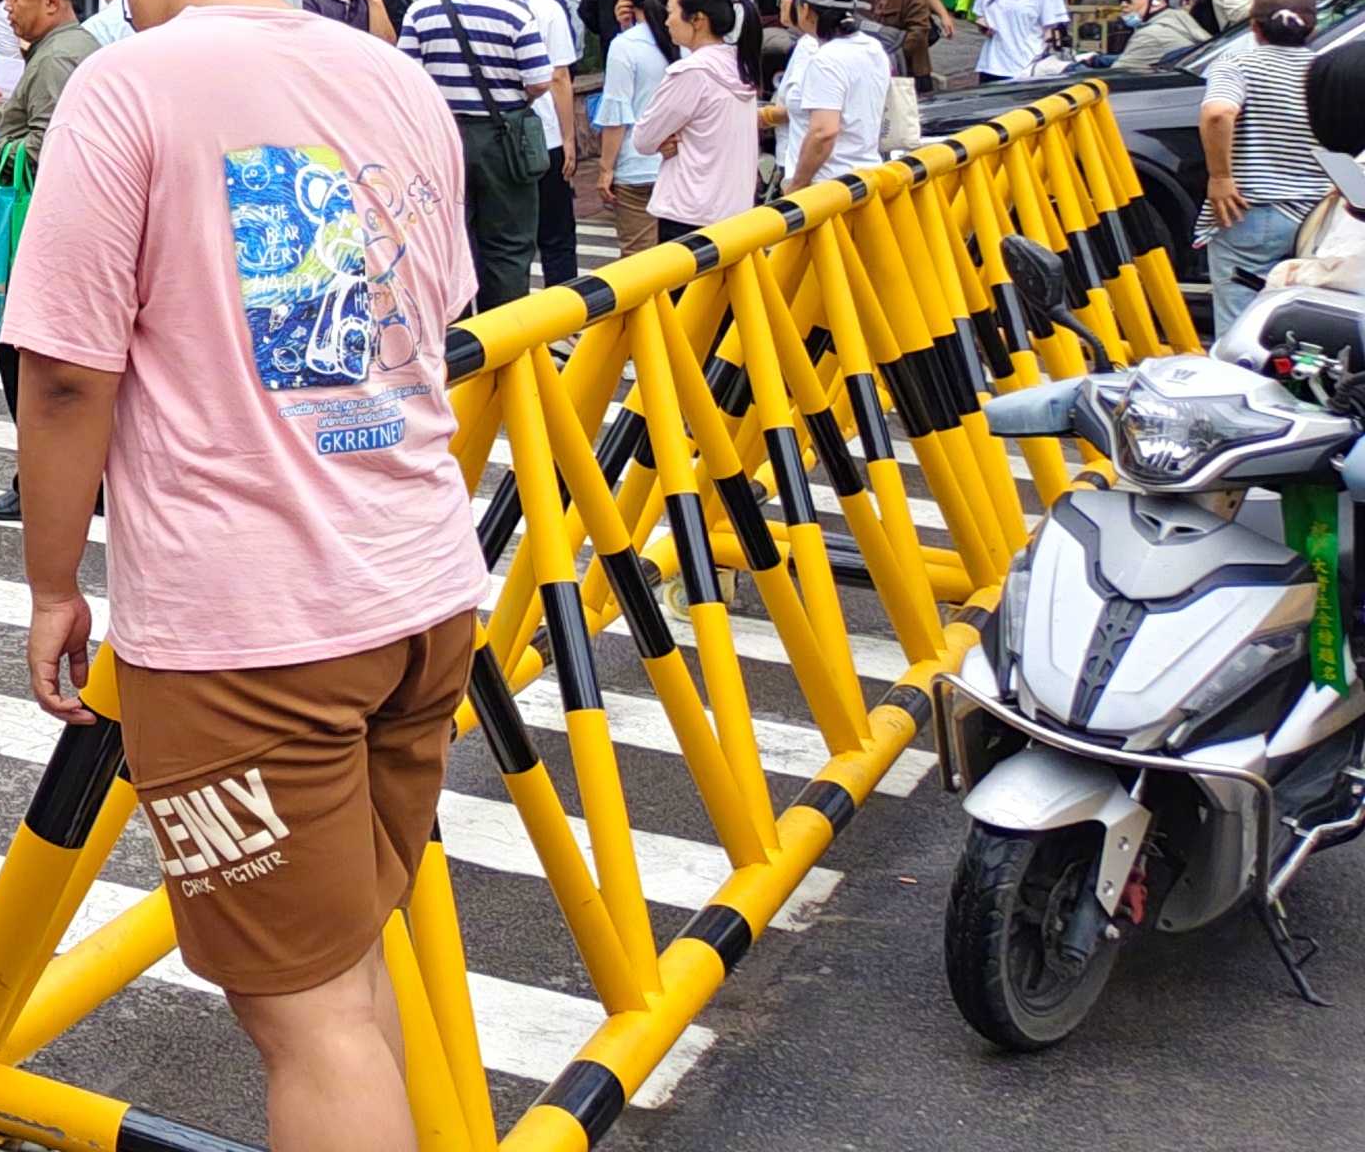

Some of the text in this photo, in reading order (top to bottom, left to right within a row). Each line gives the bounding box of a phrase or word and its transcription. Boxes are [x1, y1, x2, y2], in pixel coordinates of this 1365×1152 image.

[259, 204, 290, 221] THE
[265, 225, 300, 244] BEAR
[257, 245, 304, 266] VERY
[251, 273, 321, 297] HAPPY
